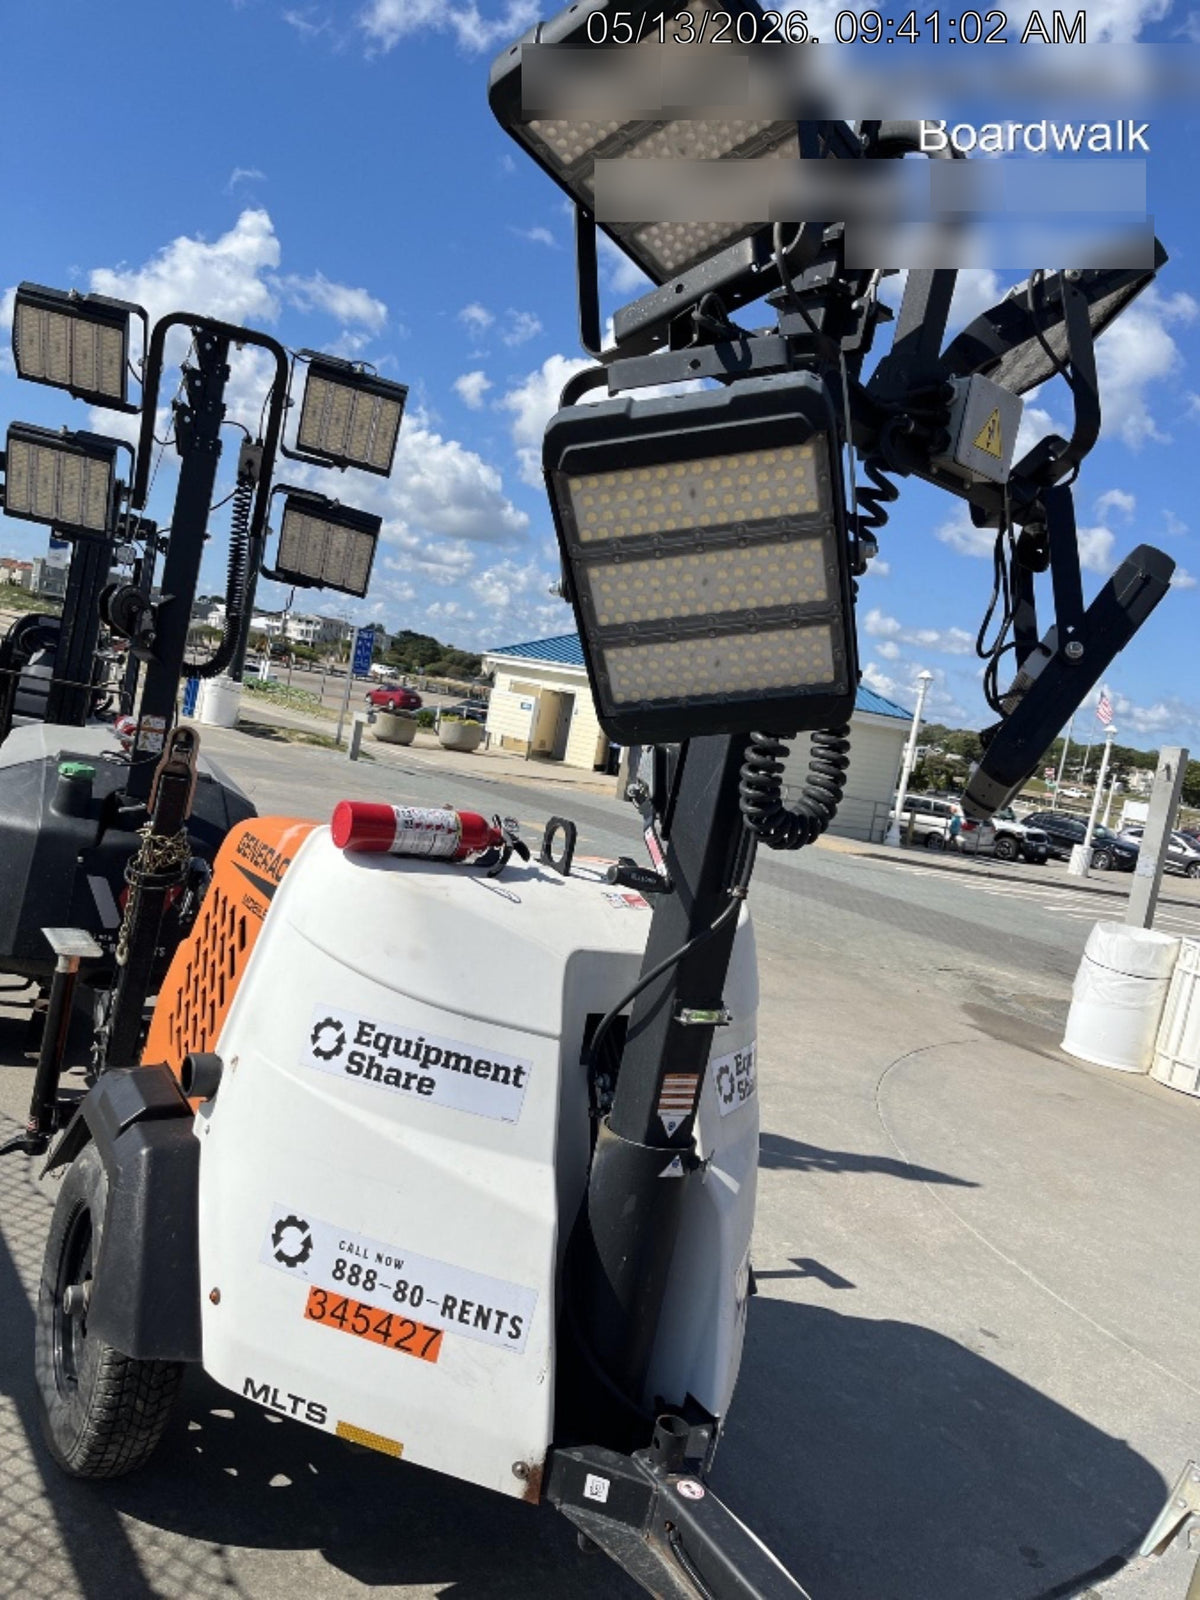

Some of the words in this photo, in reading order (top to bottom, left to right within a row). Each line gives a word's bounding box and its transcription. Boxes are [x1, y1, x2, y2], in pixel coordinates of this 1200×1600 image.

[345, 1050, 436, 1096] Share
[353, 1020, 526, 1088] Equipment
[338, 1240, 370, 1260] CALL
[374, 1253, 405, 1270] NOW
[308, 1288, 443, 1357] 345427
[331, 1258, 524, 1340] 888-80-RENTS
[242, 1376, 329, 1426] MLTS
